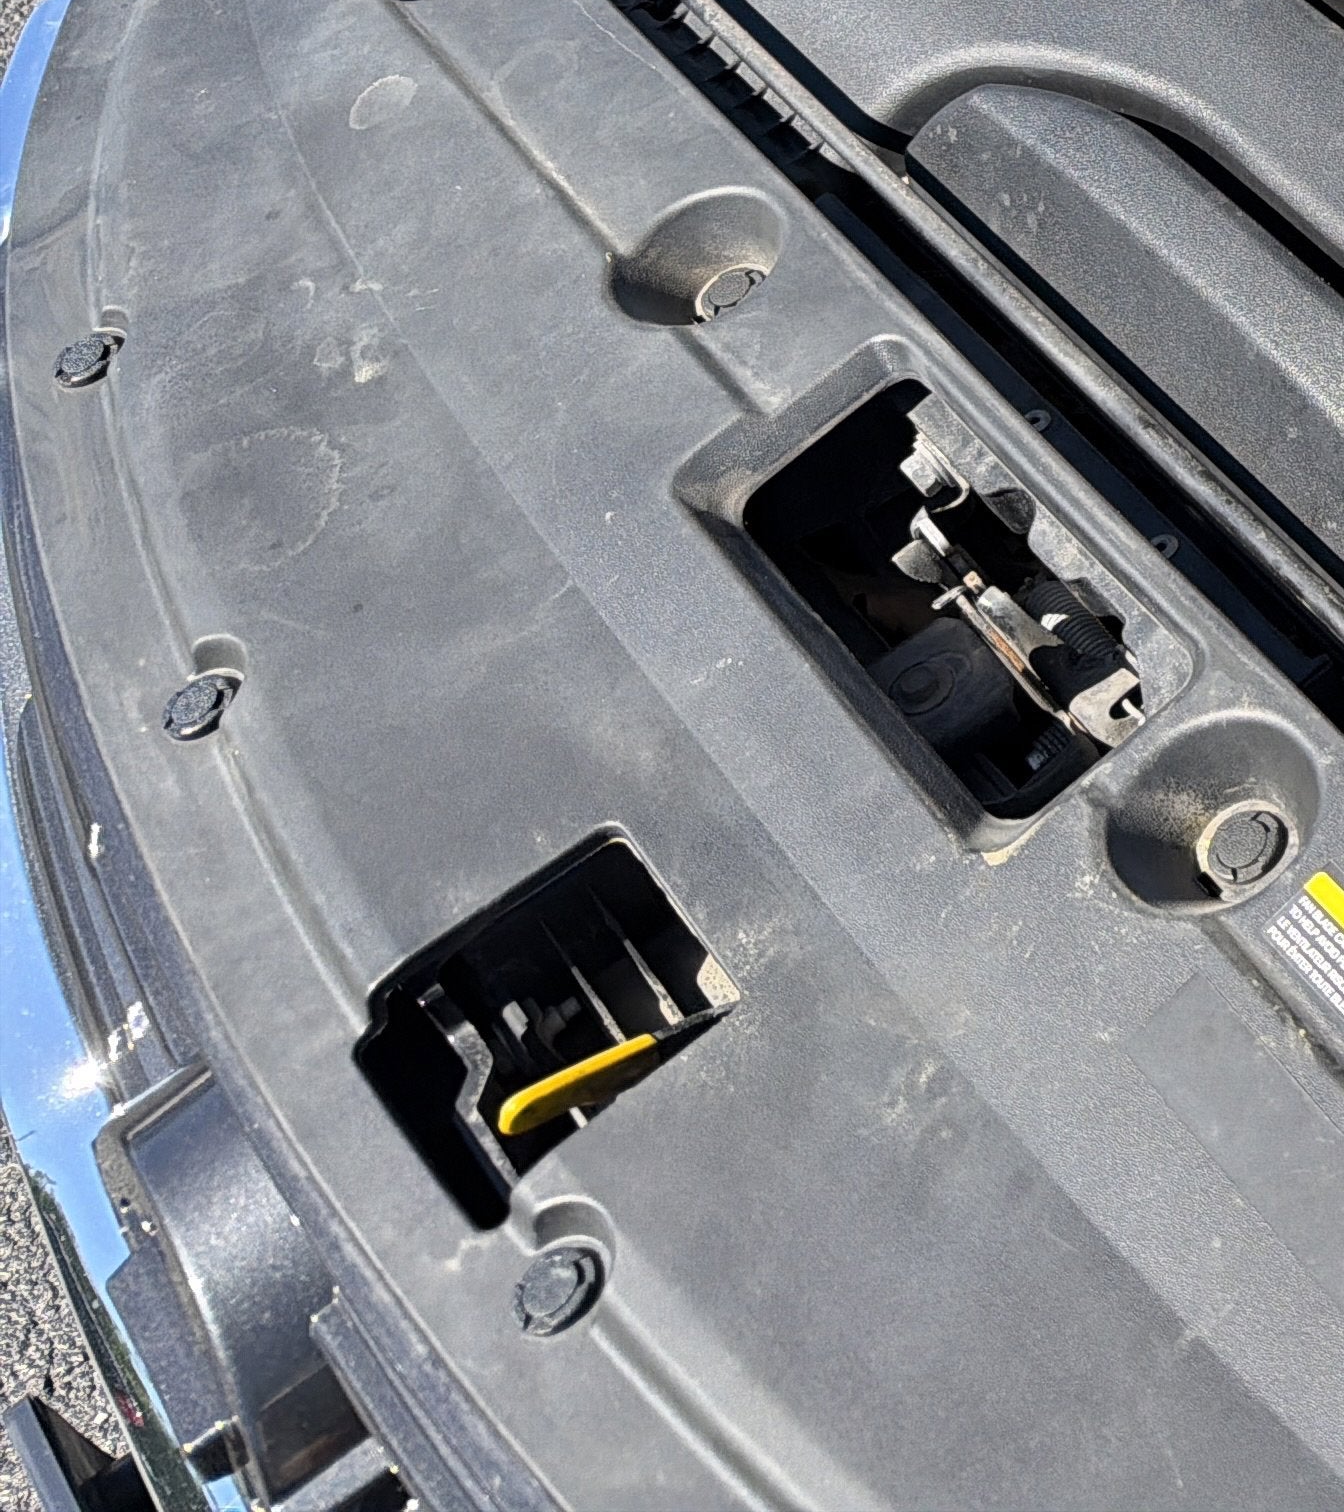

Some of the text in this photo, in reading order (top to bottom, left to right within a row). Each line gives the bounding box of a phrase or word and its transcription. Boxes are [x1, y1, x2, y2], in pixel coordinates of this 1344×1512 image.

[1287, 904, 1302, 919] TO
[1296, 914, 1320, 938] HELP
[1313, 932, 1340, 960] AVOID
[1297, 894, 1316, 914] FAN
[1311, 909, 1338, 937] BLADE
[1265, 925, 1290, 950] POUR
[1307, 969, 1335, 997] TOUTE
[1275, 915, 1290, 930] LE
[1284, 924, 1332, 974] VENTILATEUR
